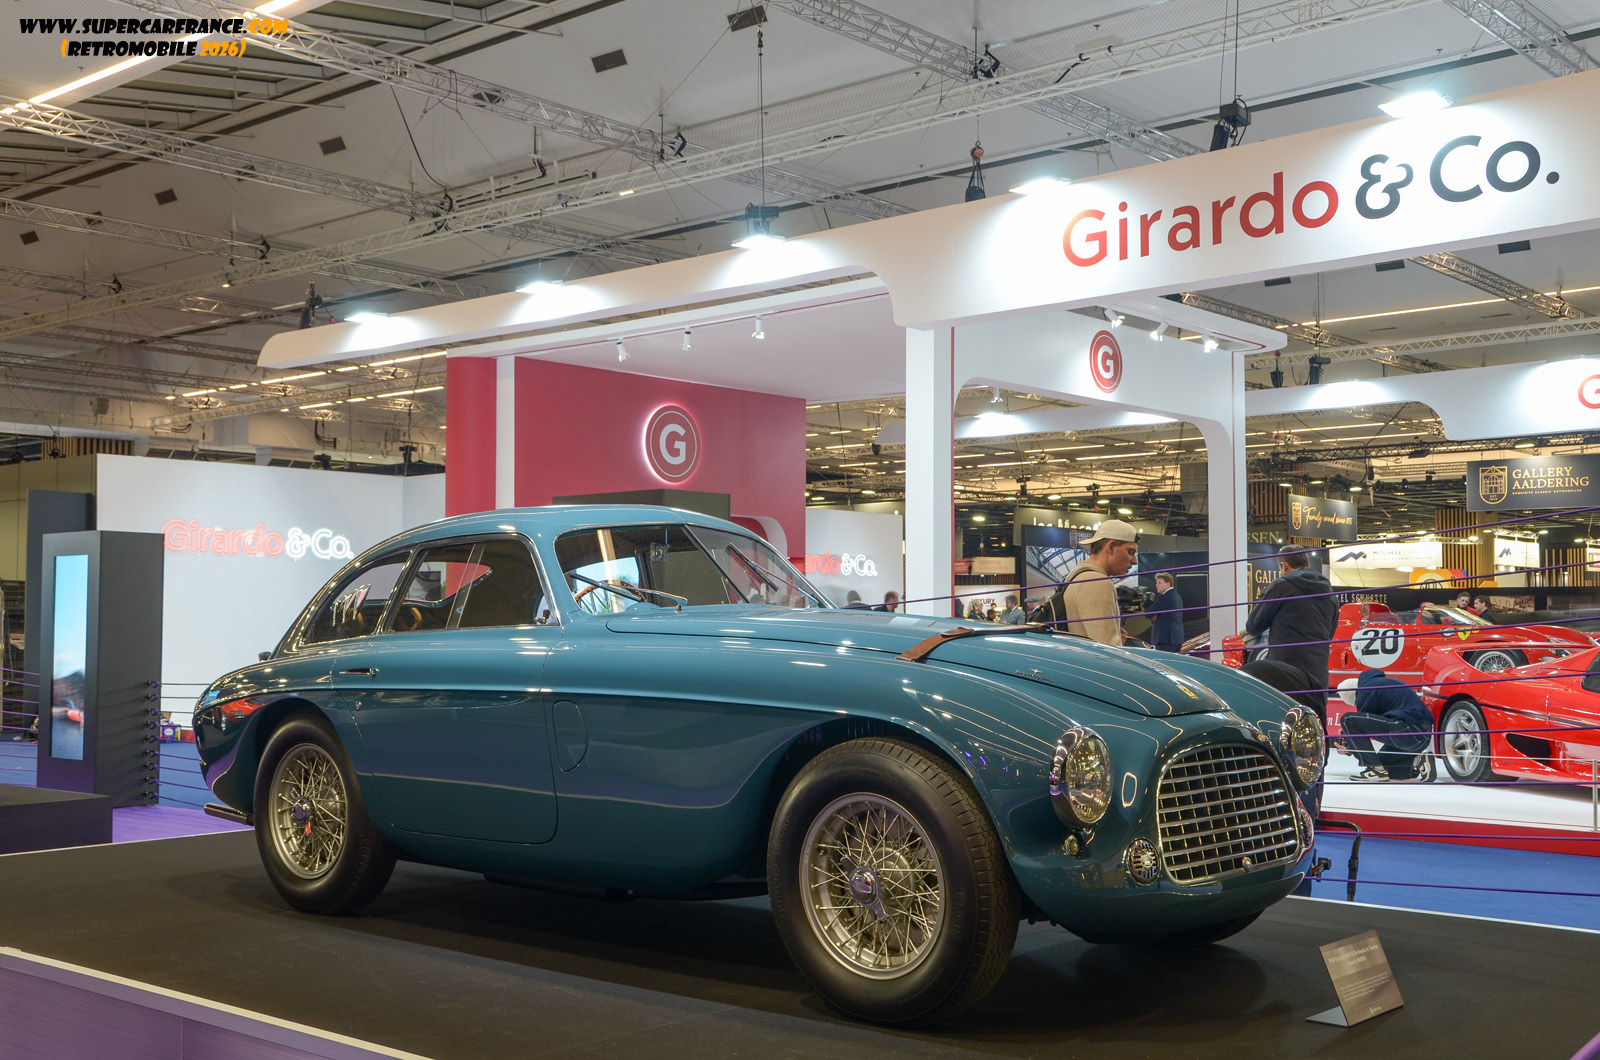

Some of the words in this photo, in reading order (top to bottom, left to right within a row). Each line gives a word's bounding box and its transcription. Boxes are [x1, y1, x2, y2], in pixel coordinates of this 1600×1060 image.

[1062, 171, 1339, 267] Girardo
[1355, 154, 1414, 220] &
[1429, 135, 1561, 203] Co.
[1097, 344, 1115, 380] G
[659, 423, 687, 466] G
[1511, 466, 1573, 479] GALLERY
[1511, 476, 1590, 490] AALDERING
[162, 519, 285, 557] Girardo
[804, 550, 841, 574] ardo
[1255, 569, 1283, 584] GALL
[1361, 628, 1400, 656] 20
